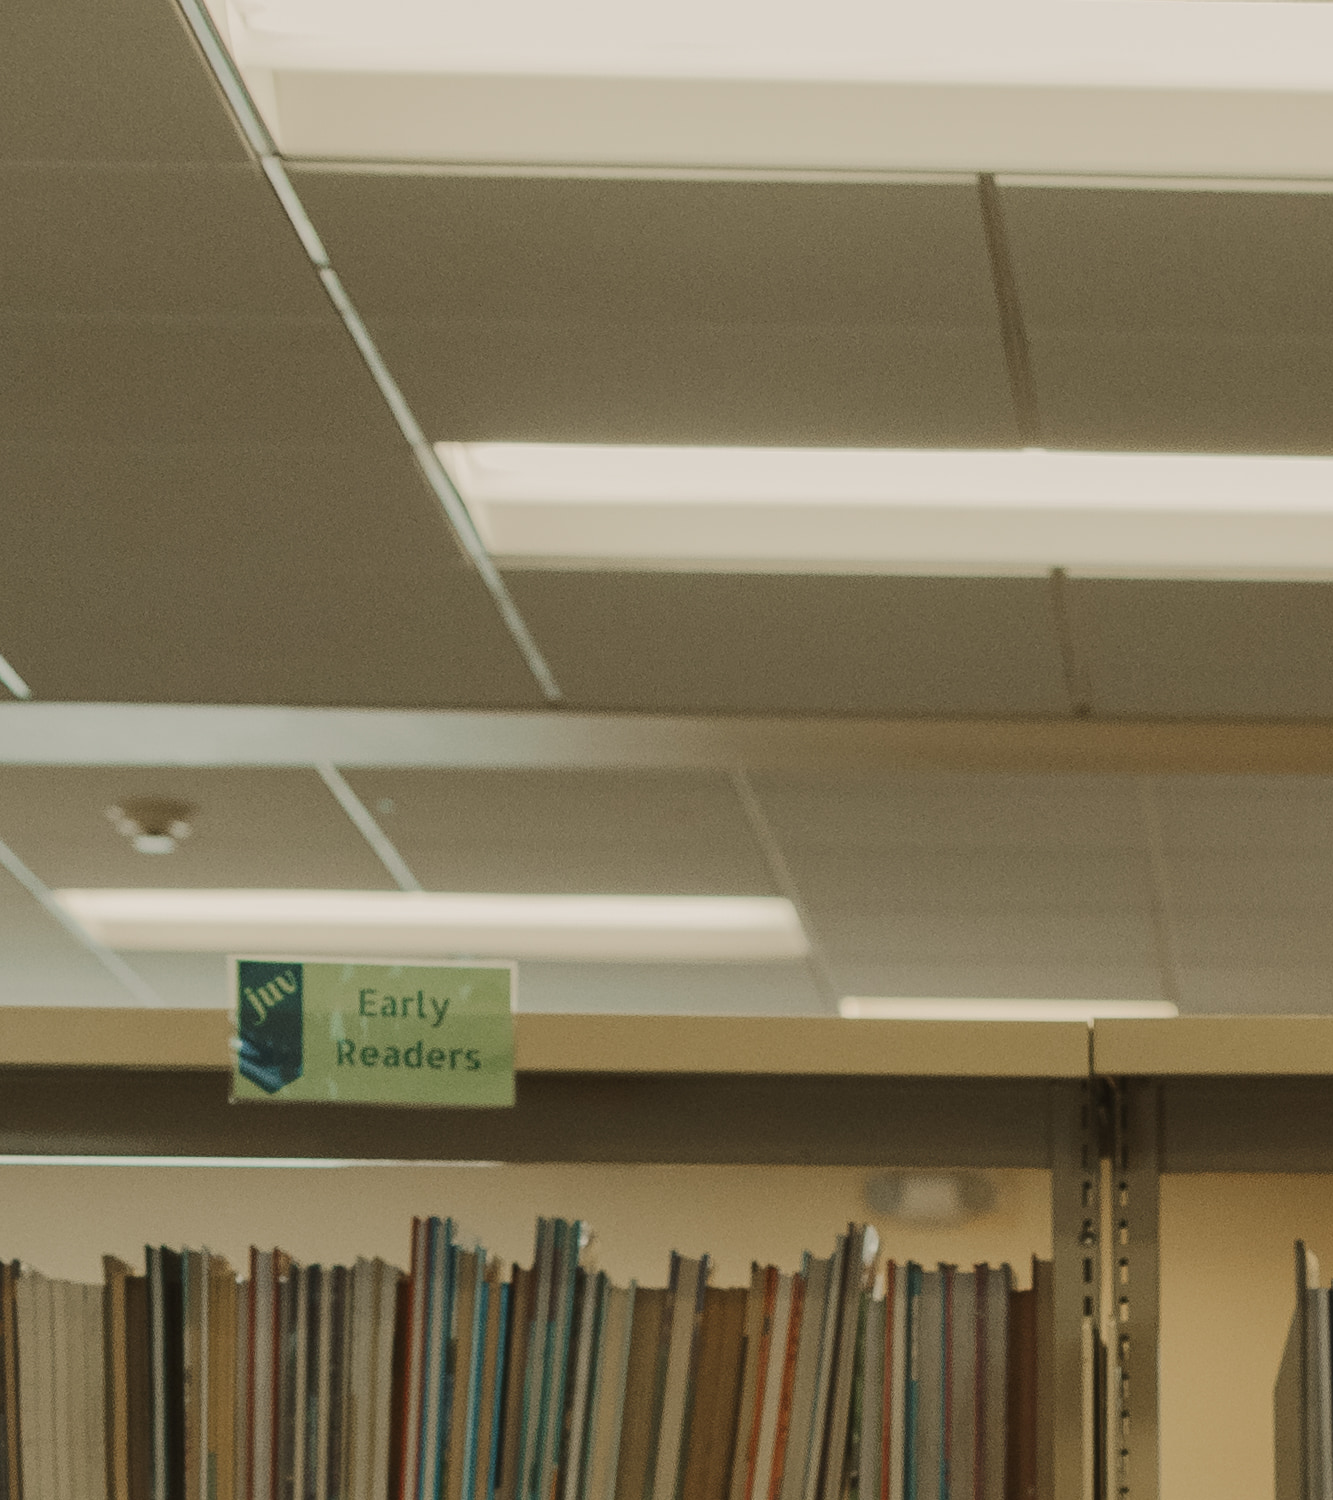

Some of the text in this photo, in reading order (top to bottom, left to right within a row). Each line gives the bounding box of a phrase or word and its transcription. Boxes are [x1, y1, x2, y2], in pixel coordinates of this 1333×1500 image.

[243, 969, 297, 1026] juv
[359, 988, 450, 1028] Early
[336, 1039, 481, 1070] Readers
